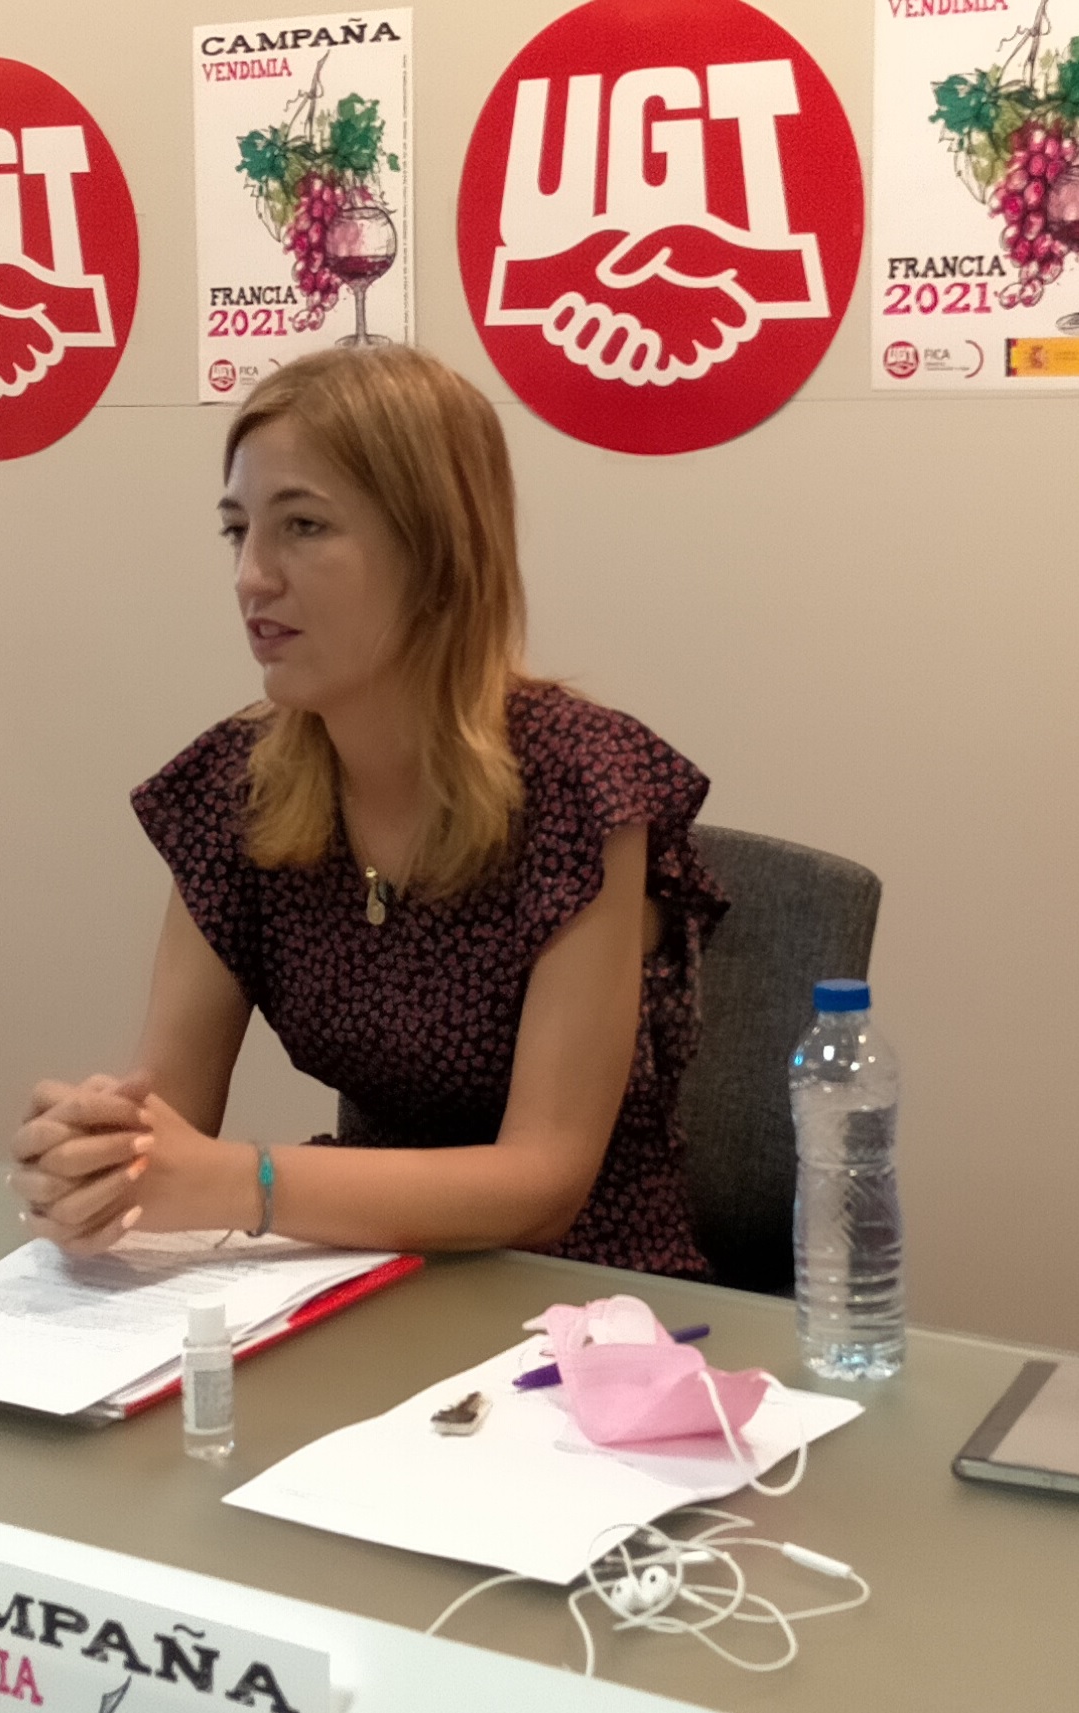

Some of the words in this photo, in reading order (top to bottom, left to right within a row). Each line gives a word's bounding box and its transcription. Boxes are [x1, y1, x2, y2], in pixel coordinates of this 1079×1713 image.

[201, 17, 401, 56] CAMPAÑA
[202, 57, 292, 82] VENDIMIA
[499, 58, 801, 246] UGT
[888, 255, 1006, 280] FRANCIA
[210, 285, 298, 306] FRANCIA
[883, 282, 992, 315] 2021
[208, 308, 288, 337] 2021
